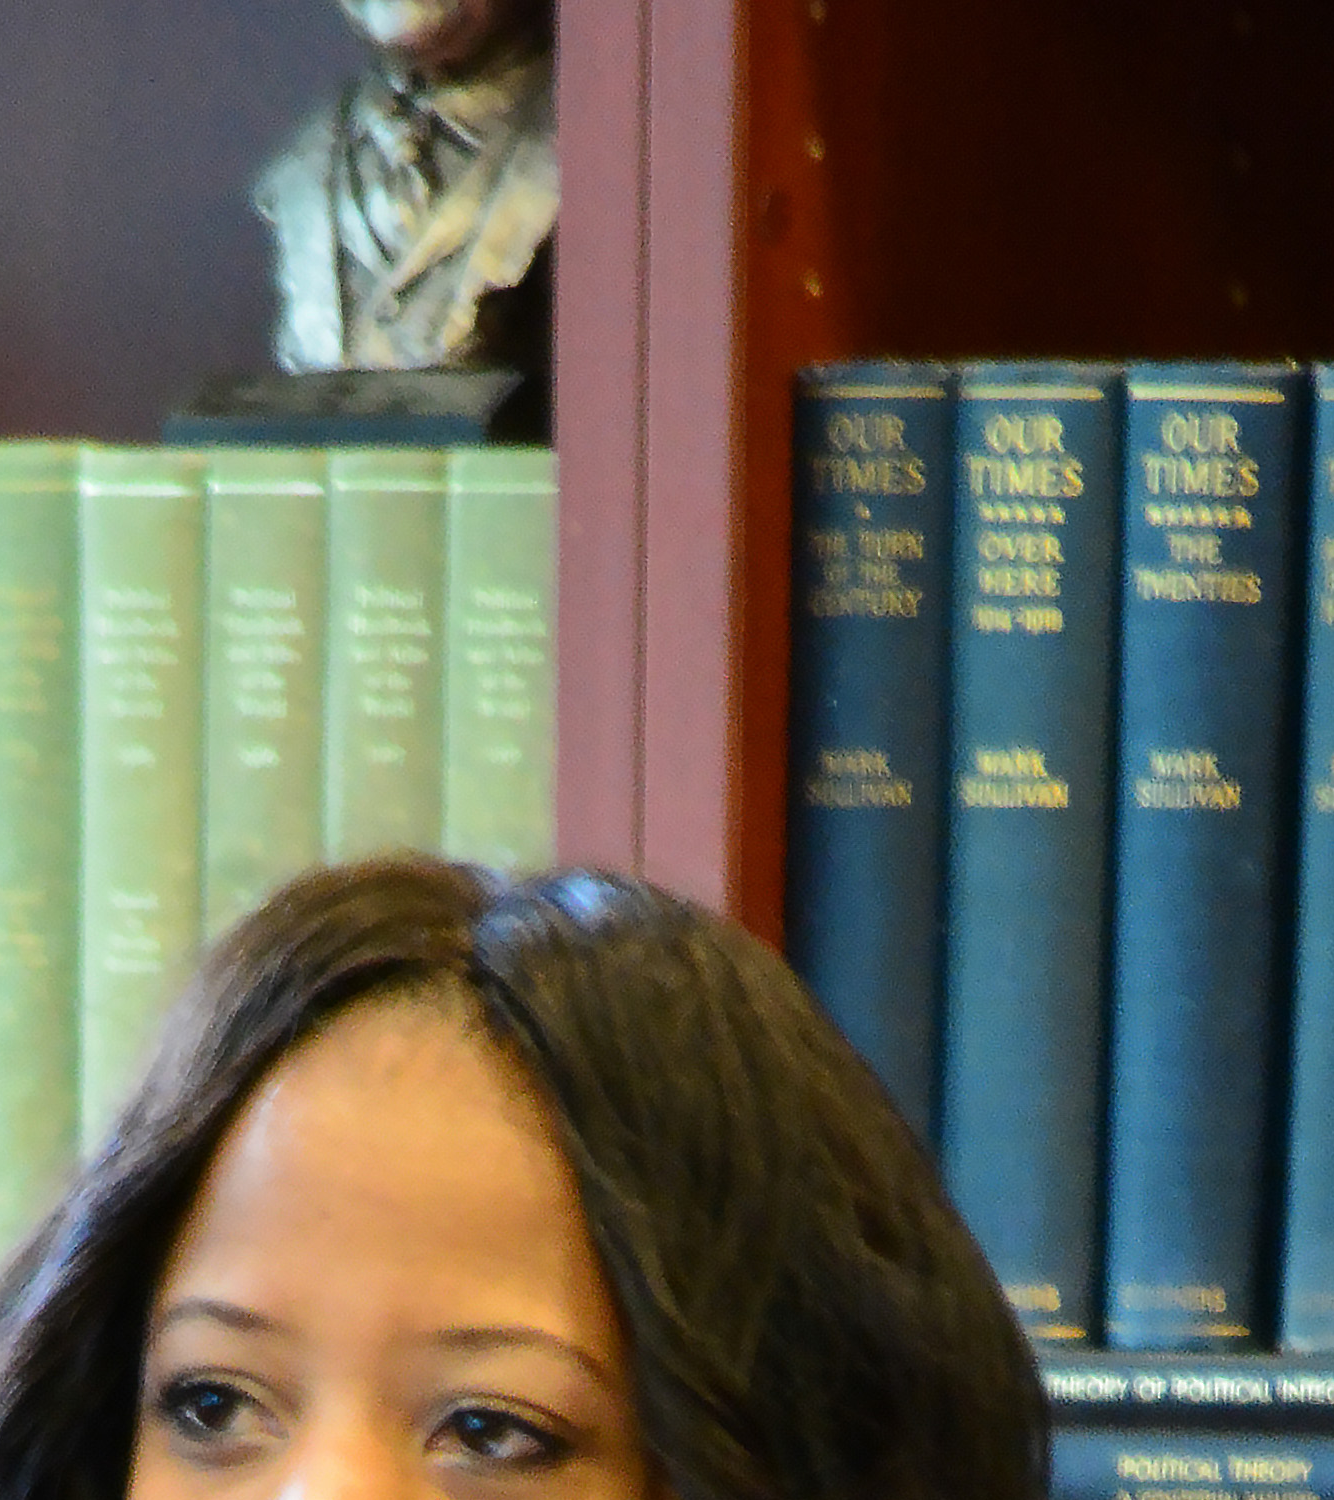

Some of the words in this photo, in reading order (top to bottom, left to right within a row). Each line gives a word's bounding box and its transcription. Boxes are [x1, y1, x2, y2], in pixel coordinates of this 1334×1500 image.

[826, 412, 905, 451] OUR
[983, 414, 1065, 453] OUR
[1160, 411, 1241, 453] OUR
[812, 456, 926, 496] TIMES
[965, 454, 1083, 496] TIMES
[1142, 453, 1261, 497] TIMES
[978, 530, 1065, 563] OVER
[1046, 1371, 1129, 1402] THEORY
[1132, 1370, 1168, 1403] OF
[1170, 1373, 1272, 1406] POLITICAL
[1117, 1453, 1223, 1483] POLITICAL
[1227, 1453, 1314, 1484] THEORY
